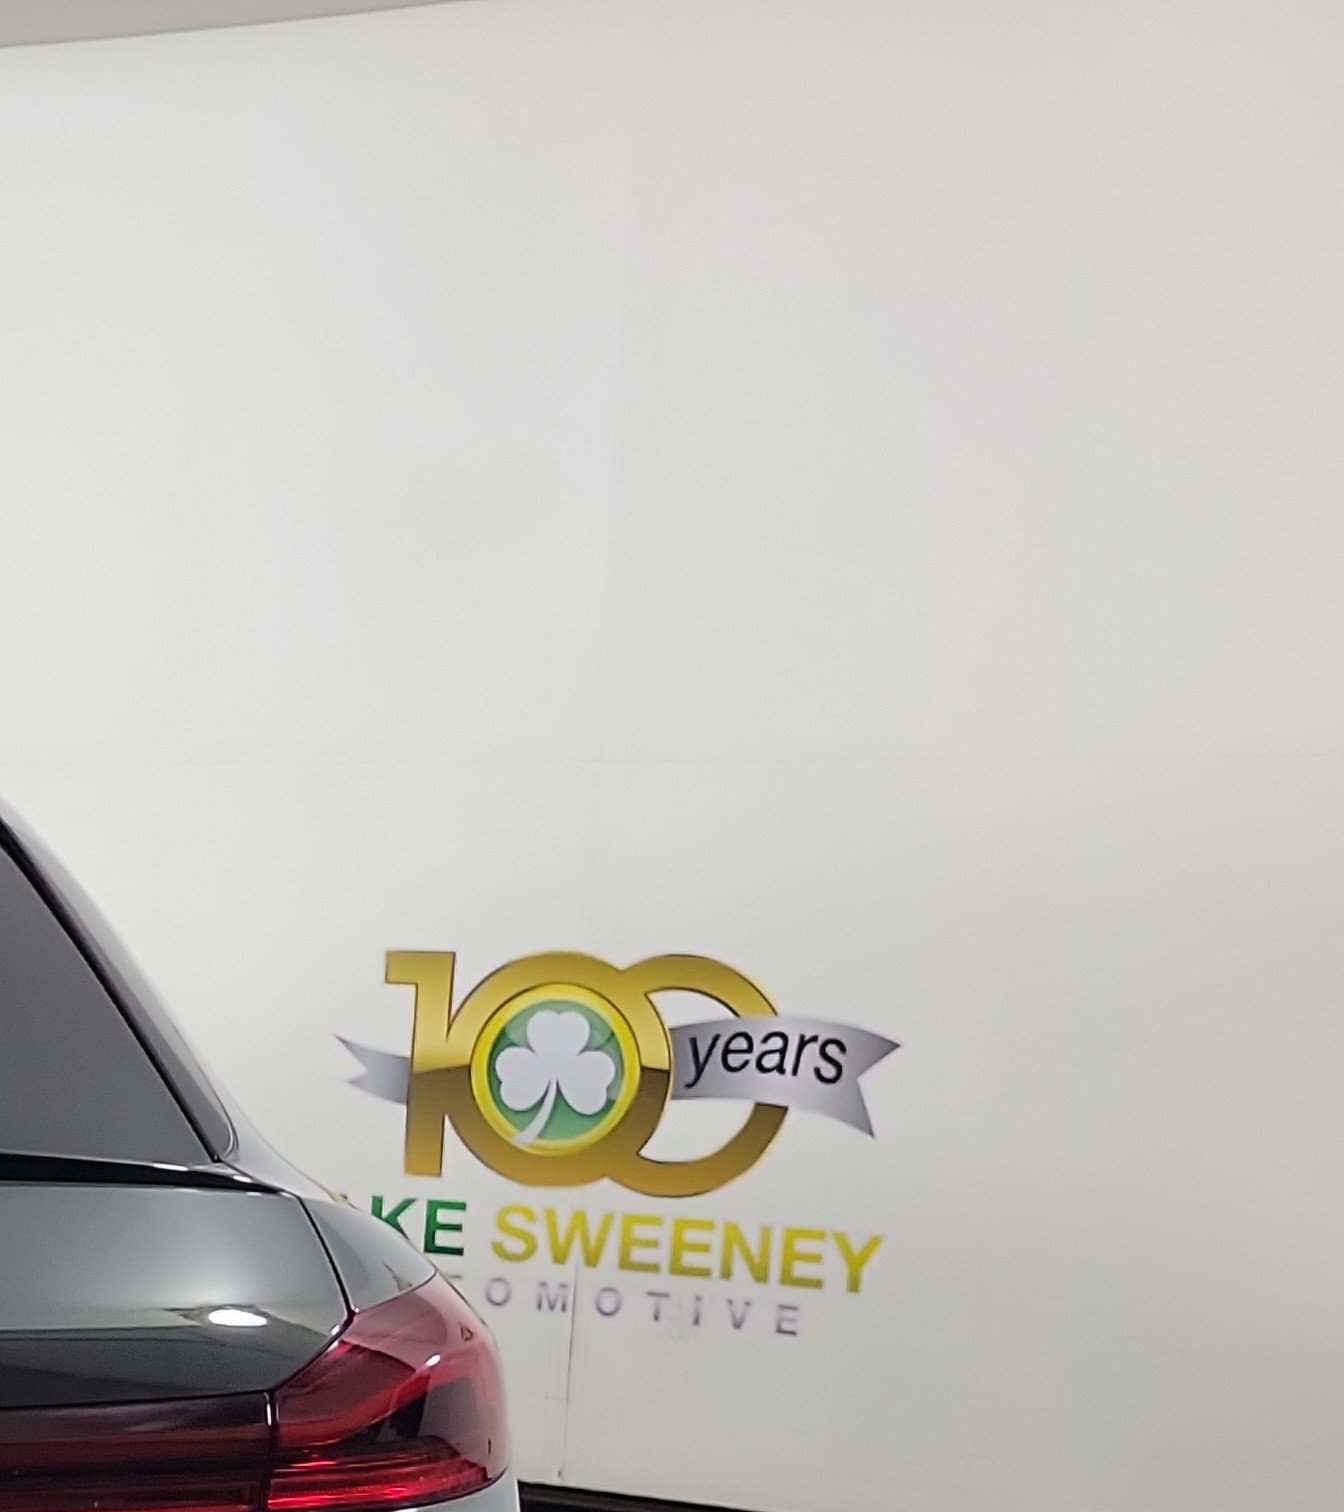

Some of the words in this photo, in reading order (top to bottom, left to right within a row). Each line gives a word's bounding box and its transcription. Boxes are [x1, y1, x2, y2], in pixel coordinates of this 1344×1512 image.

[385, 950, 789, 1198] 100
[684, 1029, 849, 1090] years
[370, 1195, 467, 1256] KE
[491, 1205, 884, 1294] SWEENEY
[446, 1274, 801, 1337] OMOTIVE
